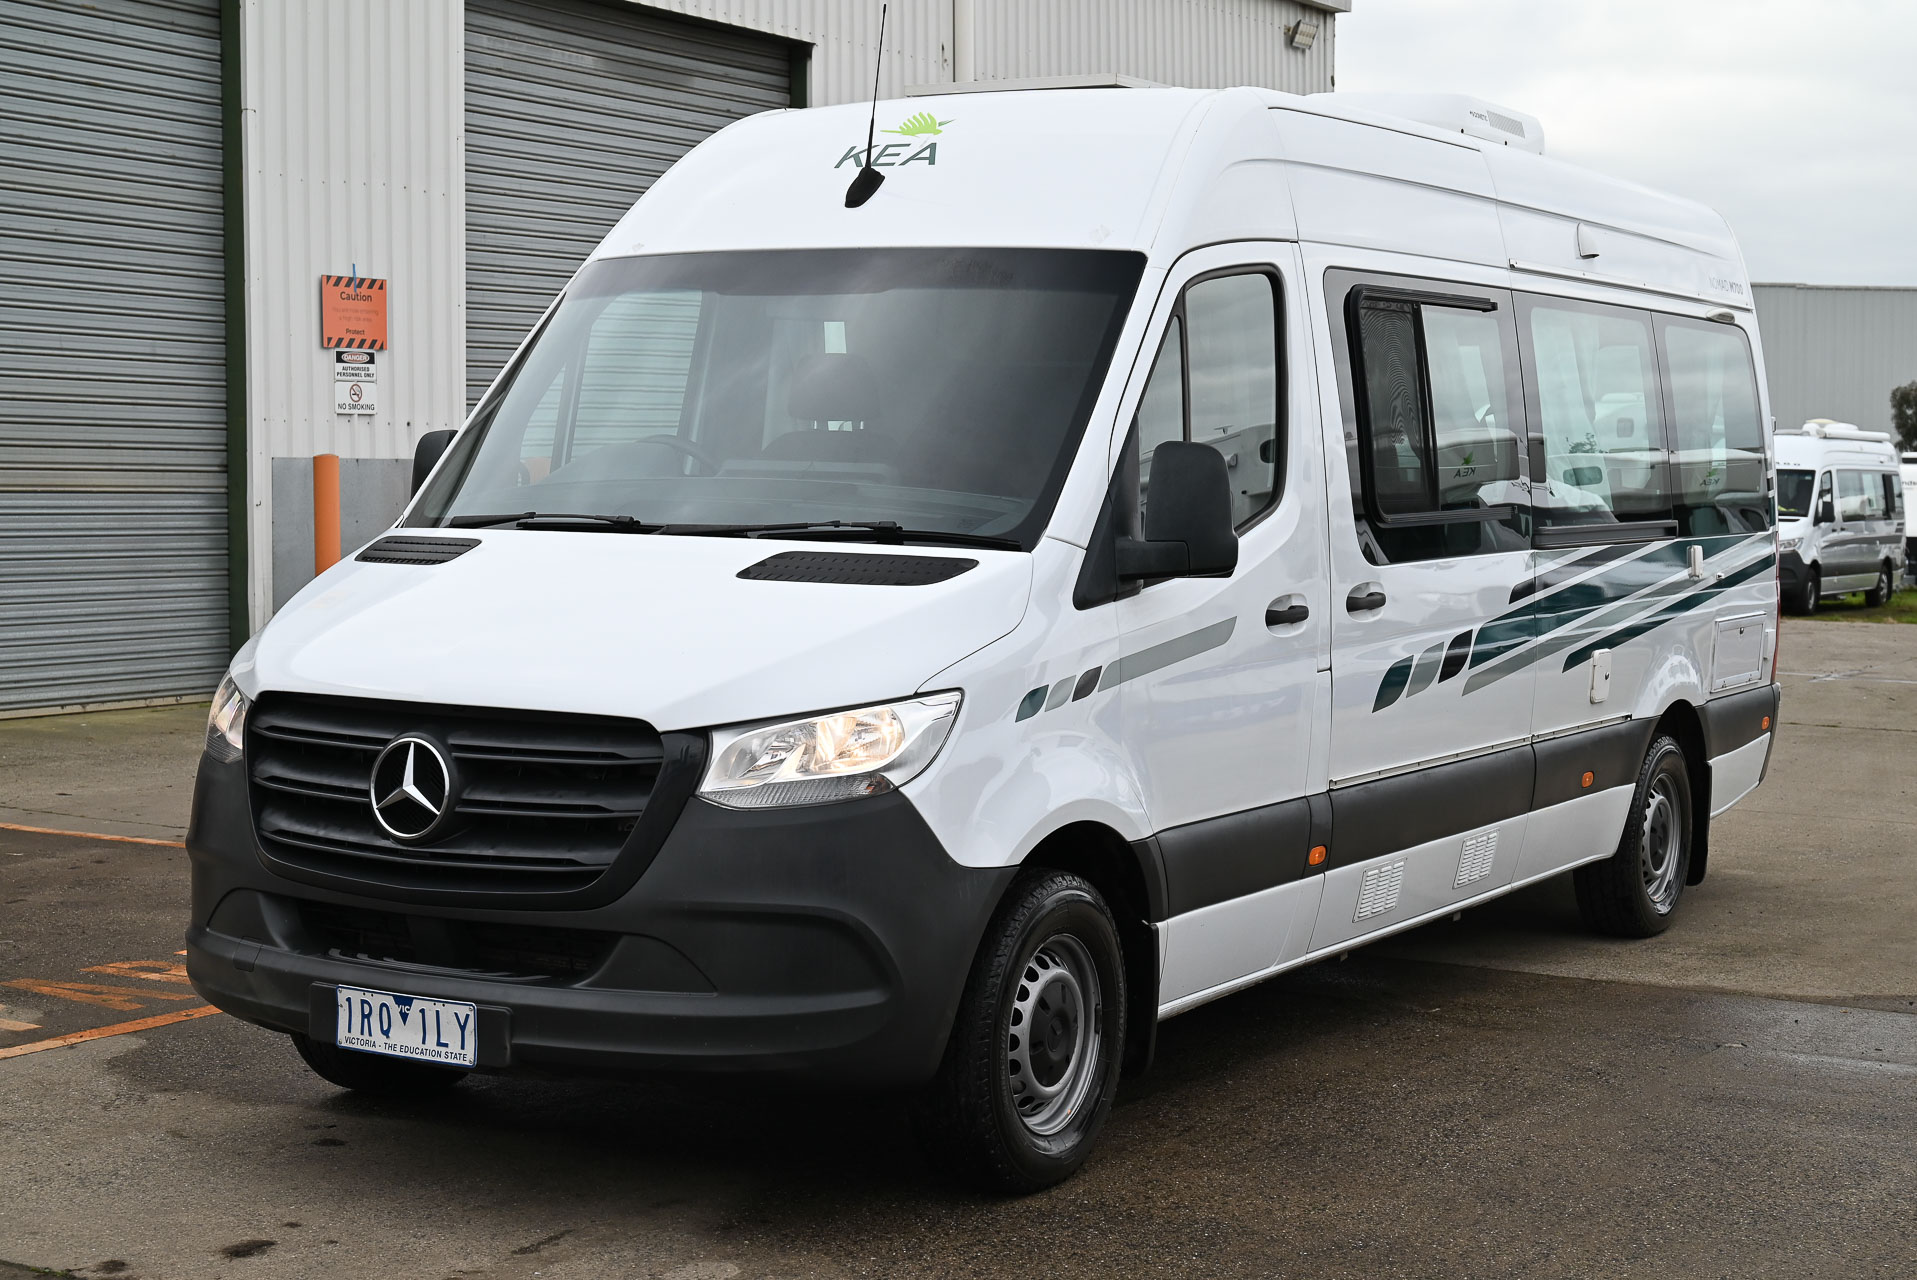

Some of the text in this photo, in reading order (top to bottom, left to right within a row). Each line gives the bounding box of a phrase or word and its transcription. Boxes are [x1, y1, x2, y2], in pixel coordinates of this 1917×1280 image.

[834, 142, 937, 169] KEA
[340, 291, 373, 303] Caution
[346, 328, 365, 336] Protect
[348, 403, 375, 411] SMOKING
[397, 1004, 411, 1014] VIC
[345, 996, 470, 1051] 1RQ 1LY
[344, 1035, 377, 1048] VICTORIA
[383, 1042, 397, 1052] THE
[399, 1045, 442, 1059] EDUCATION
[443, 1051, 468, 1062] STATE
